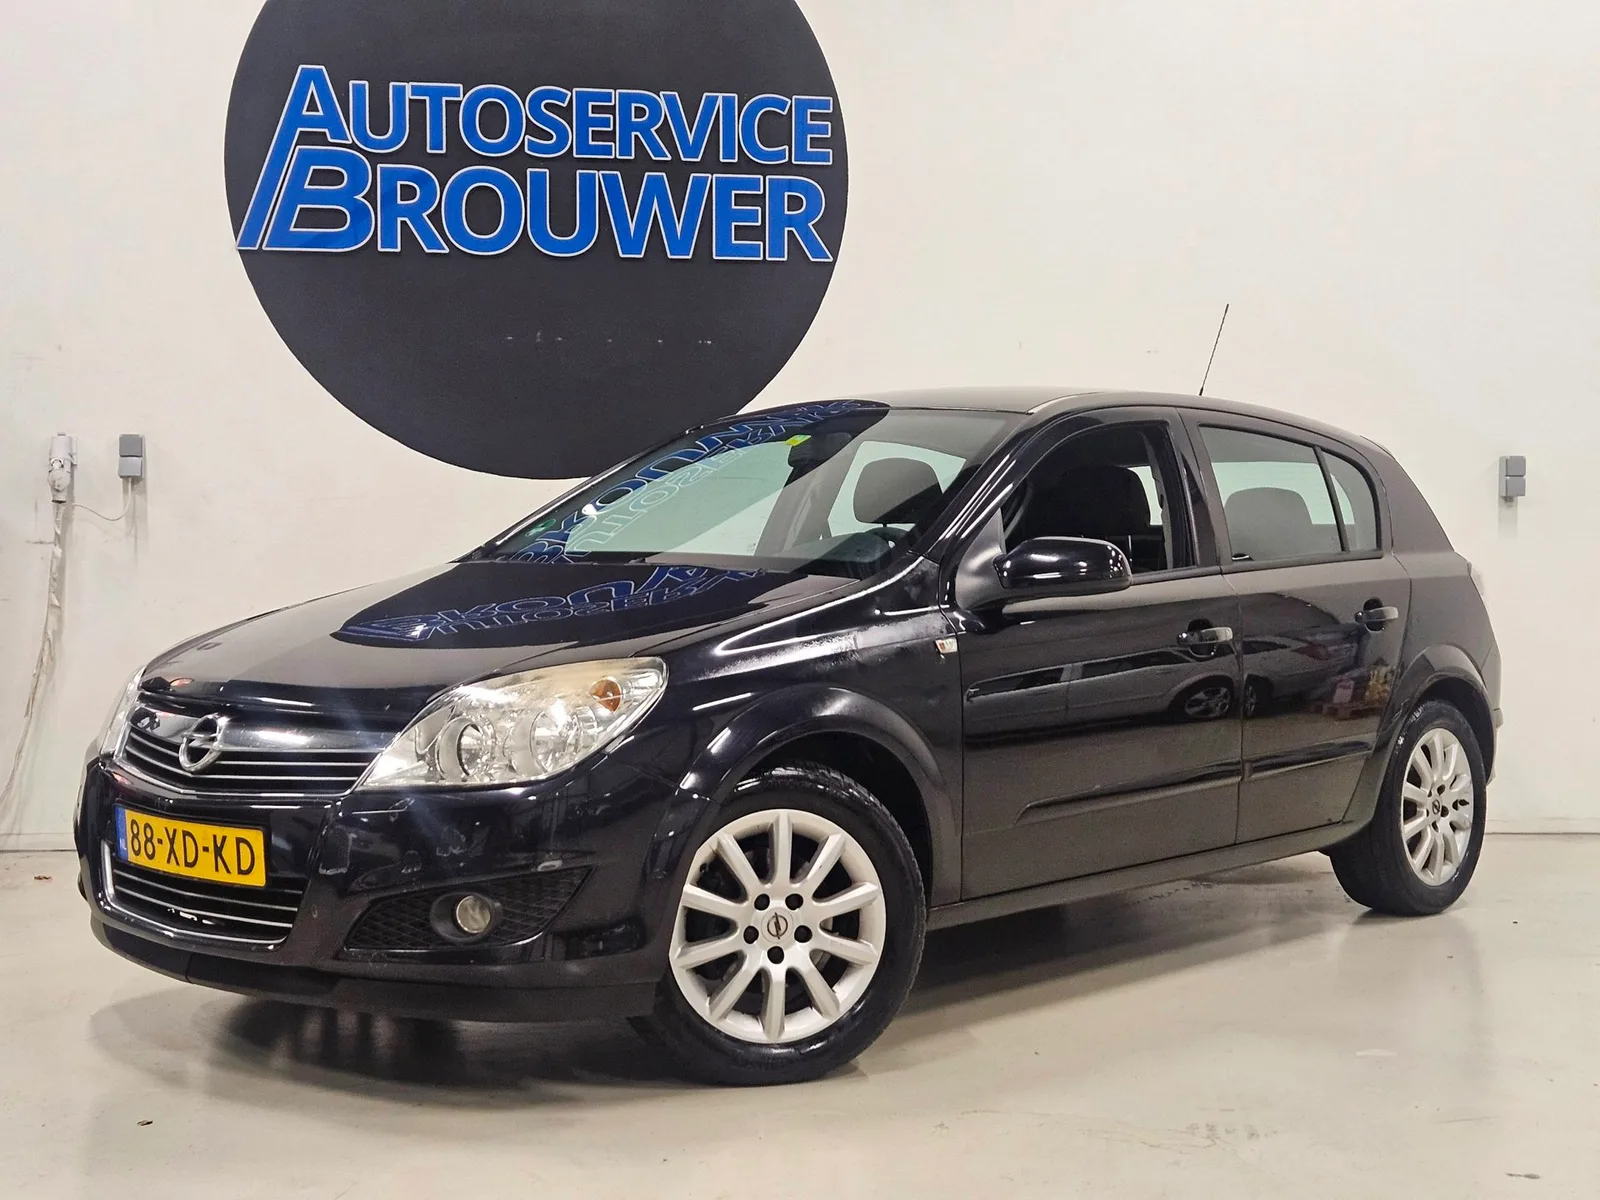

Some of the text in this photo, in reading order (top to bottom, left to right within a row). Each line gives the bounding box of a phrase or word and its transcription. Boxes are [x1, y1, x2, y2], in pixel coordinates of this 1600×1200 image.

[237, 65, 833, 250] AUTOSERVICE
[262, 146, 833, 262] BROUWER
[130, 818, 256, 876] 88-XD-KD
